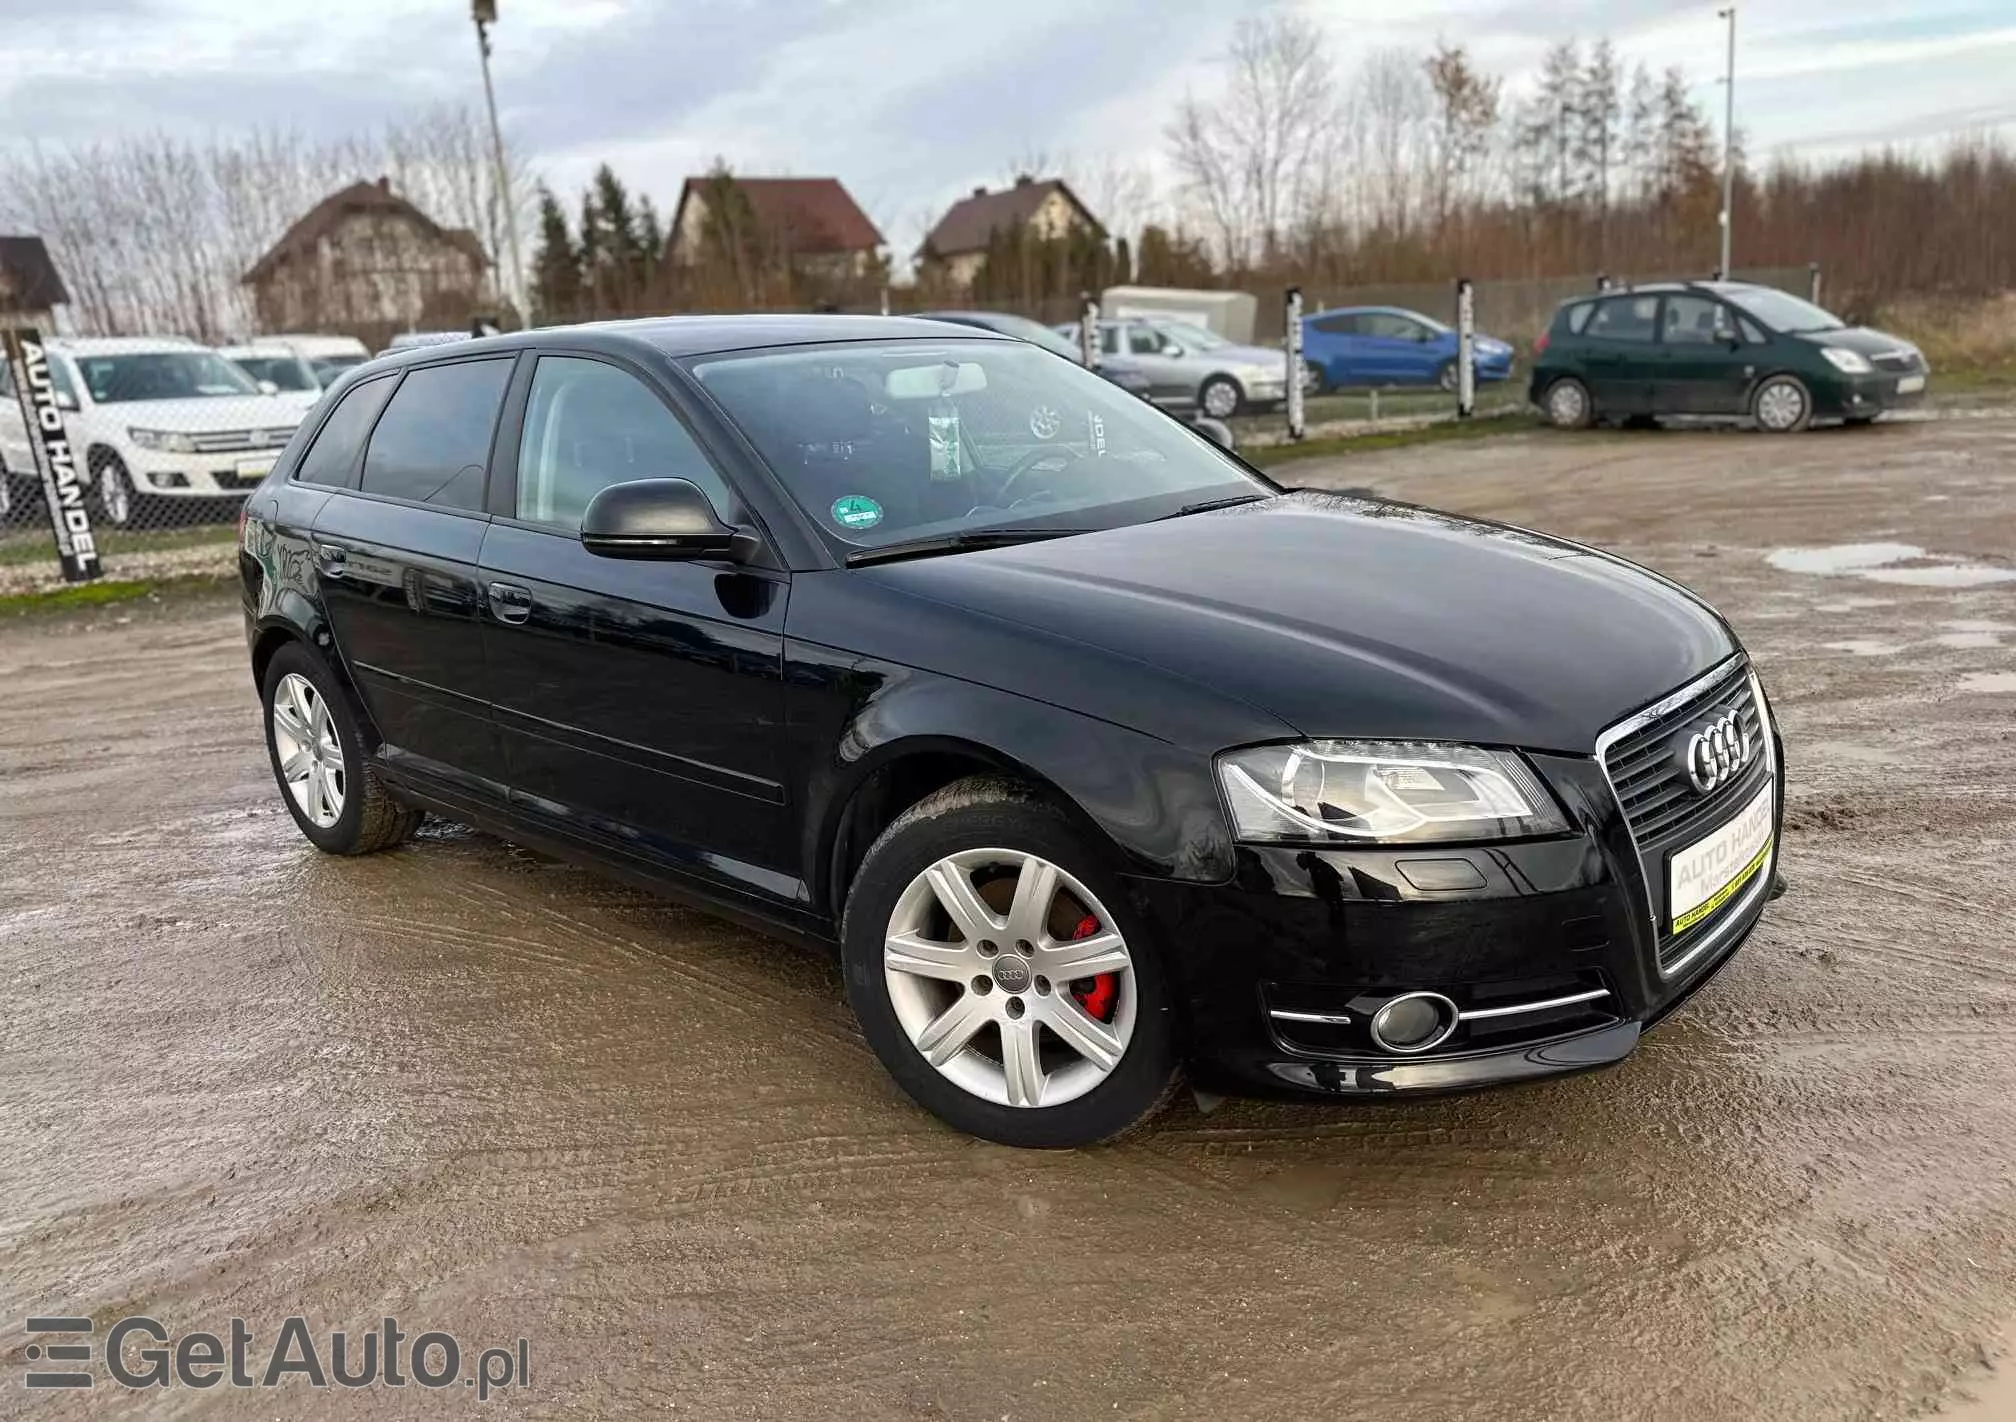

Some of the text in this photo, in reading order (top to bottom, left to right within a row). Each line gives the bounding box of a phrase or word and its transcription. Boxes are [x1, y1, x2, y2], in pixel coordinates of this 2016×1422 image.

[21, 339, 97, 571] AUTO HANDEL
[1677, 839, 1728, 889] AUTO
